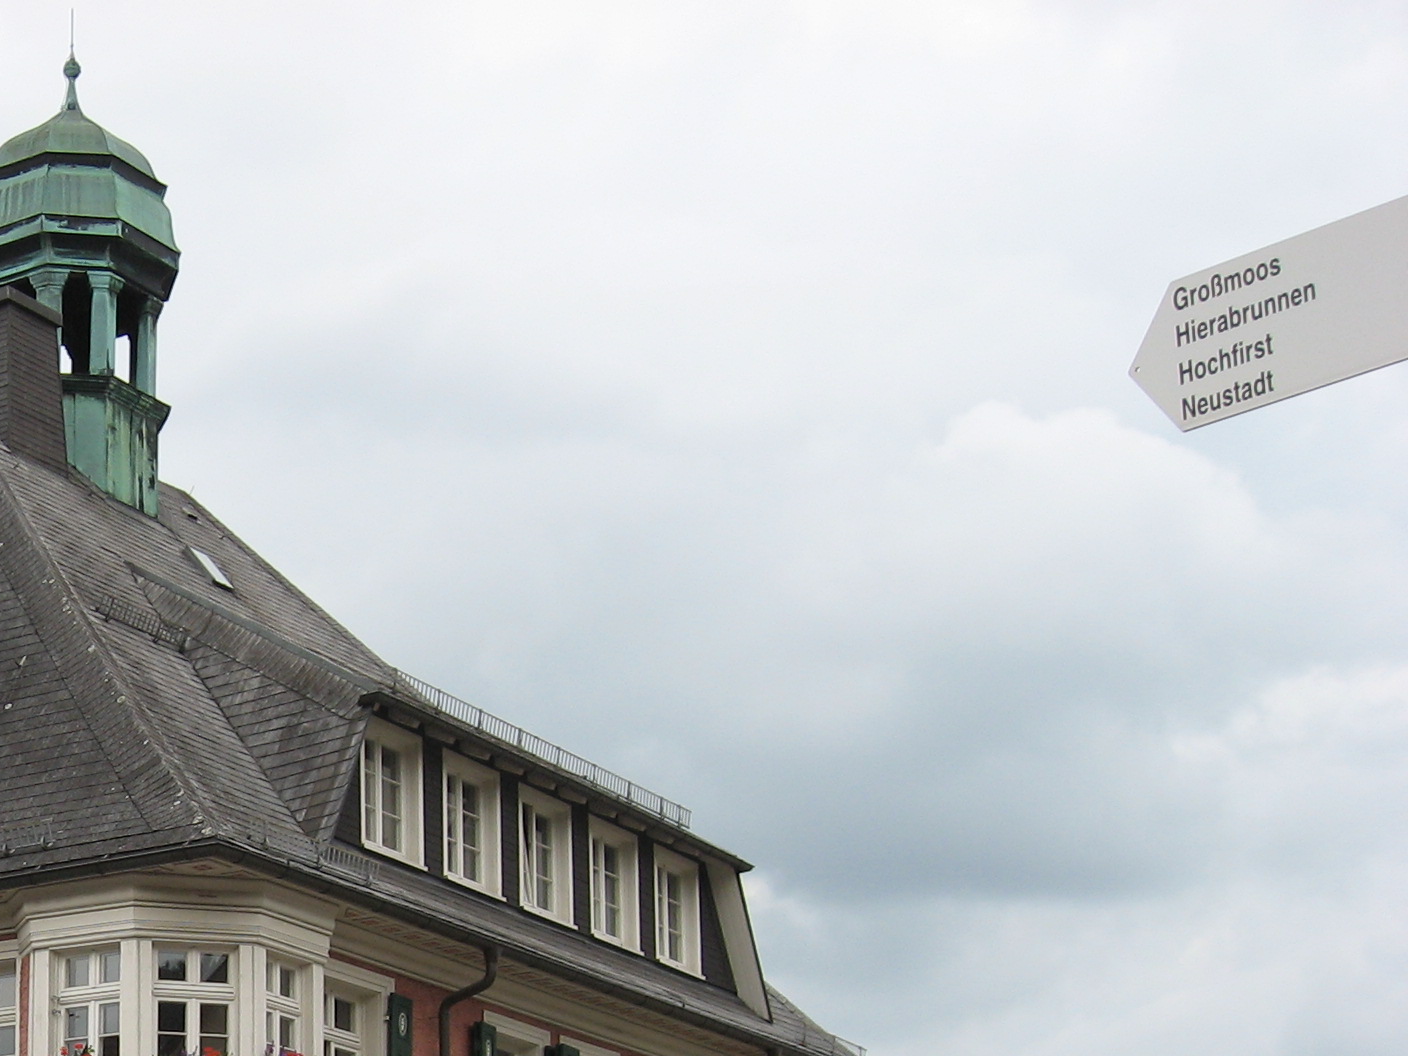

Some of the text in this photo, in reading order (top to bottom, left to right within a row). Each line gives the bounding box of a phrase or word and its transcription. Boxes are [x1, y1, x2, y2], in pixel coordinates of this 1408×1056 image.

[1173, 257, 1282, 311] Großmoos
[1175, 282, 1317, 348] Hierabrunnen
[1178, 333, 1274, 386] Hochfirst
[1181, 370, 1275, 421] Neustadt
